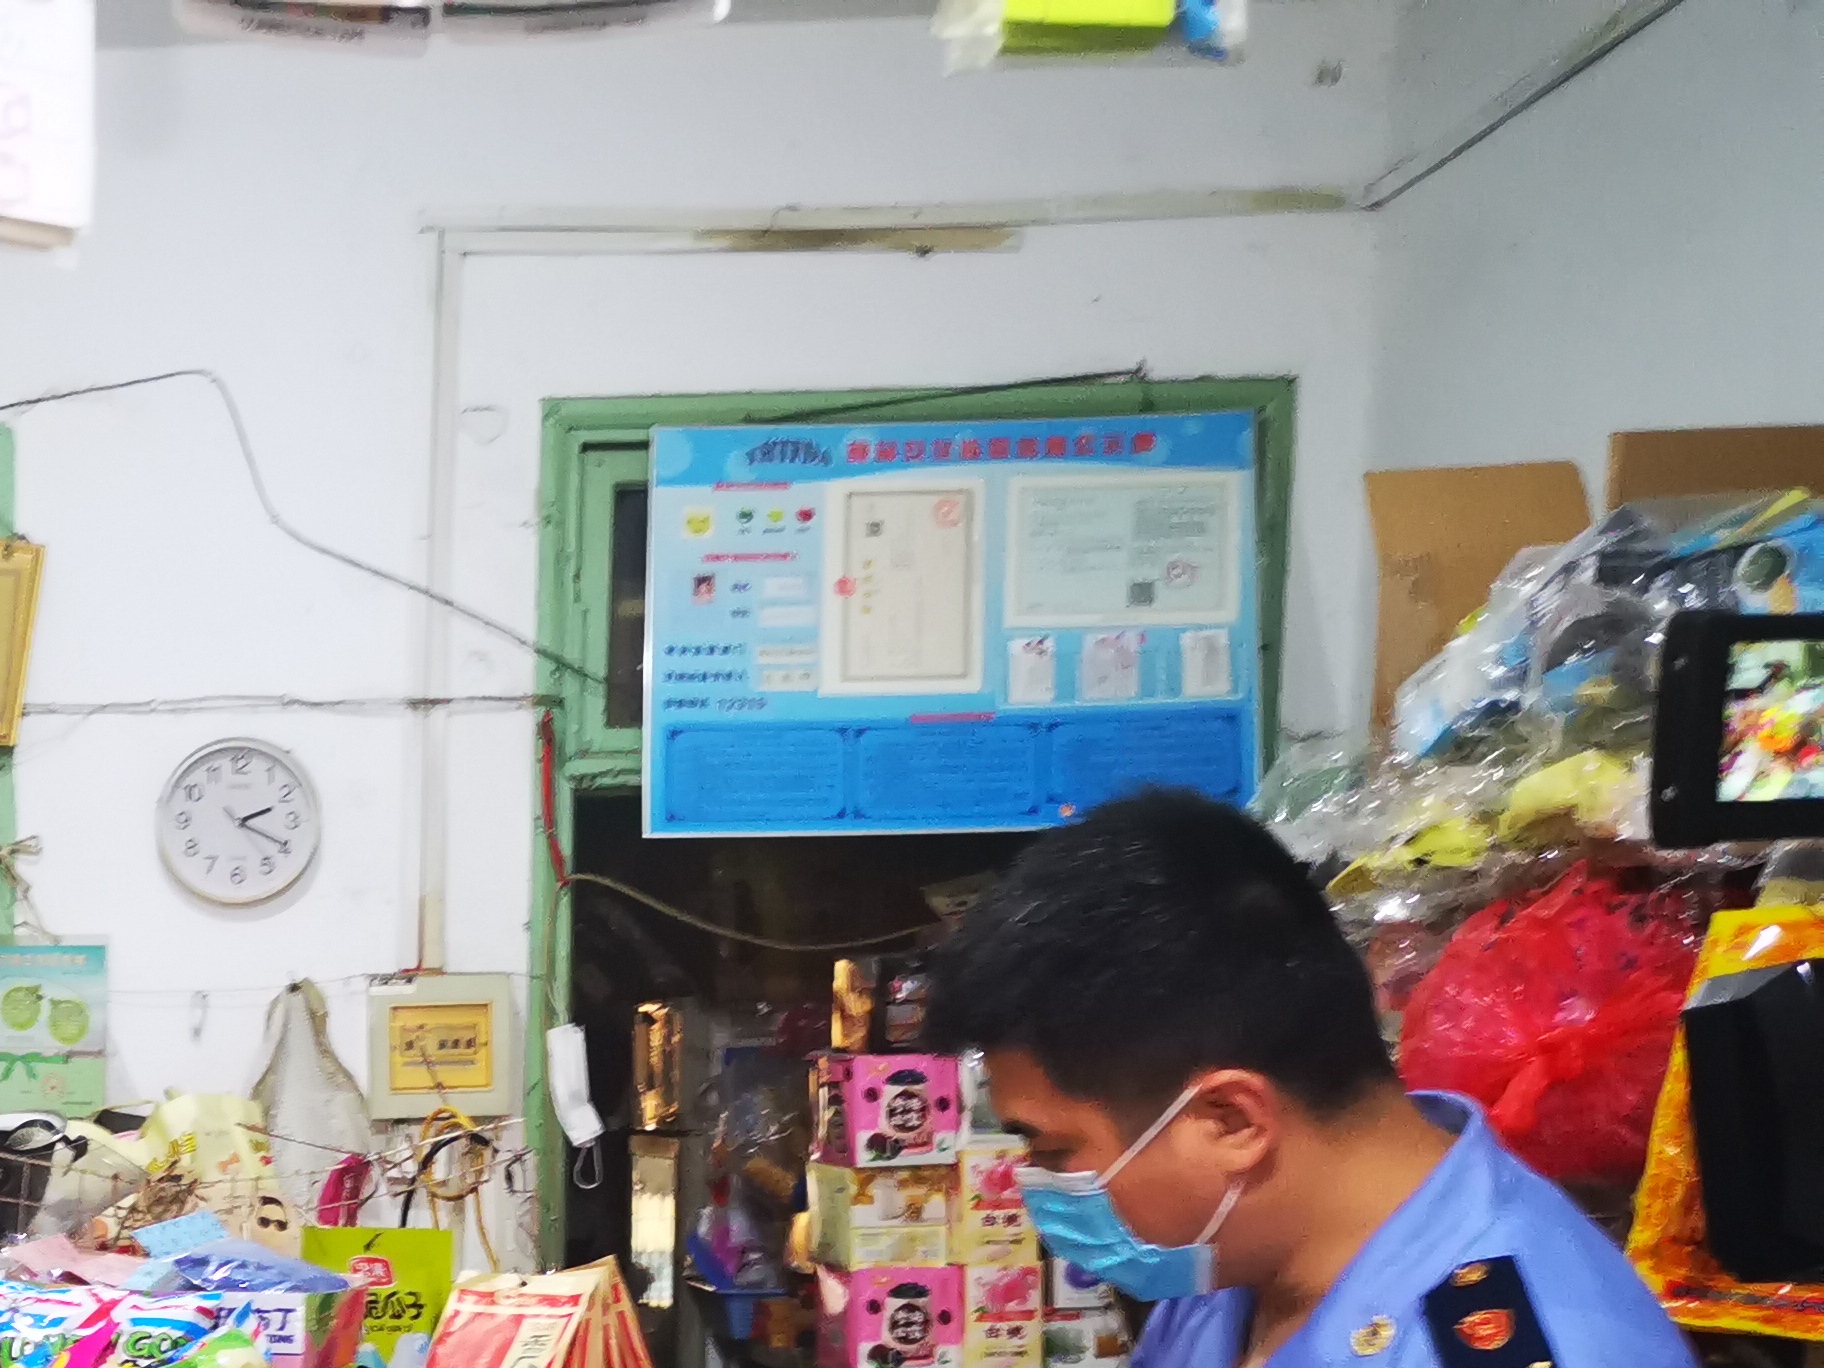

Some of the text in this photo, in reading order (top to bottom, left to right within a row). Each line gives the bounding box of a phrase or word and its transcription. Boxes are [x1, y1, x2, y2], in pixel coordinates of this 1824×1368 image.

[230, 752, 253, 775] 12
[266, 763, 277, 785] 1
[183, 783, 206, 802] 10
[278, 783, 297, 803] 2
[174, 811, 193, 830] 9
[284, 811, 302, 830] 3
[183, 837, 201, 857] 8
[203, 854, 220, 875] 7
[258, 856, 277, 876] 5
[229, 866, 249, 885] 6
